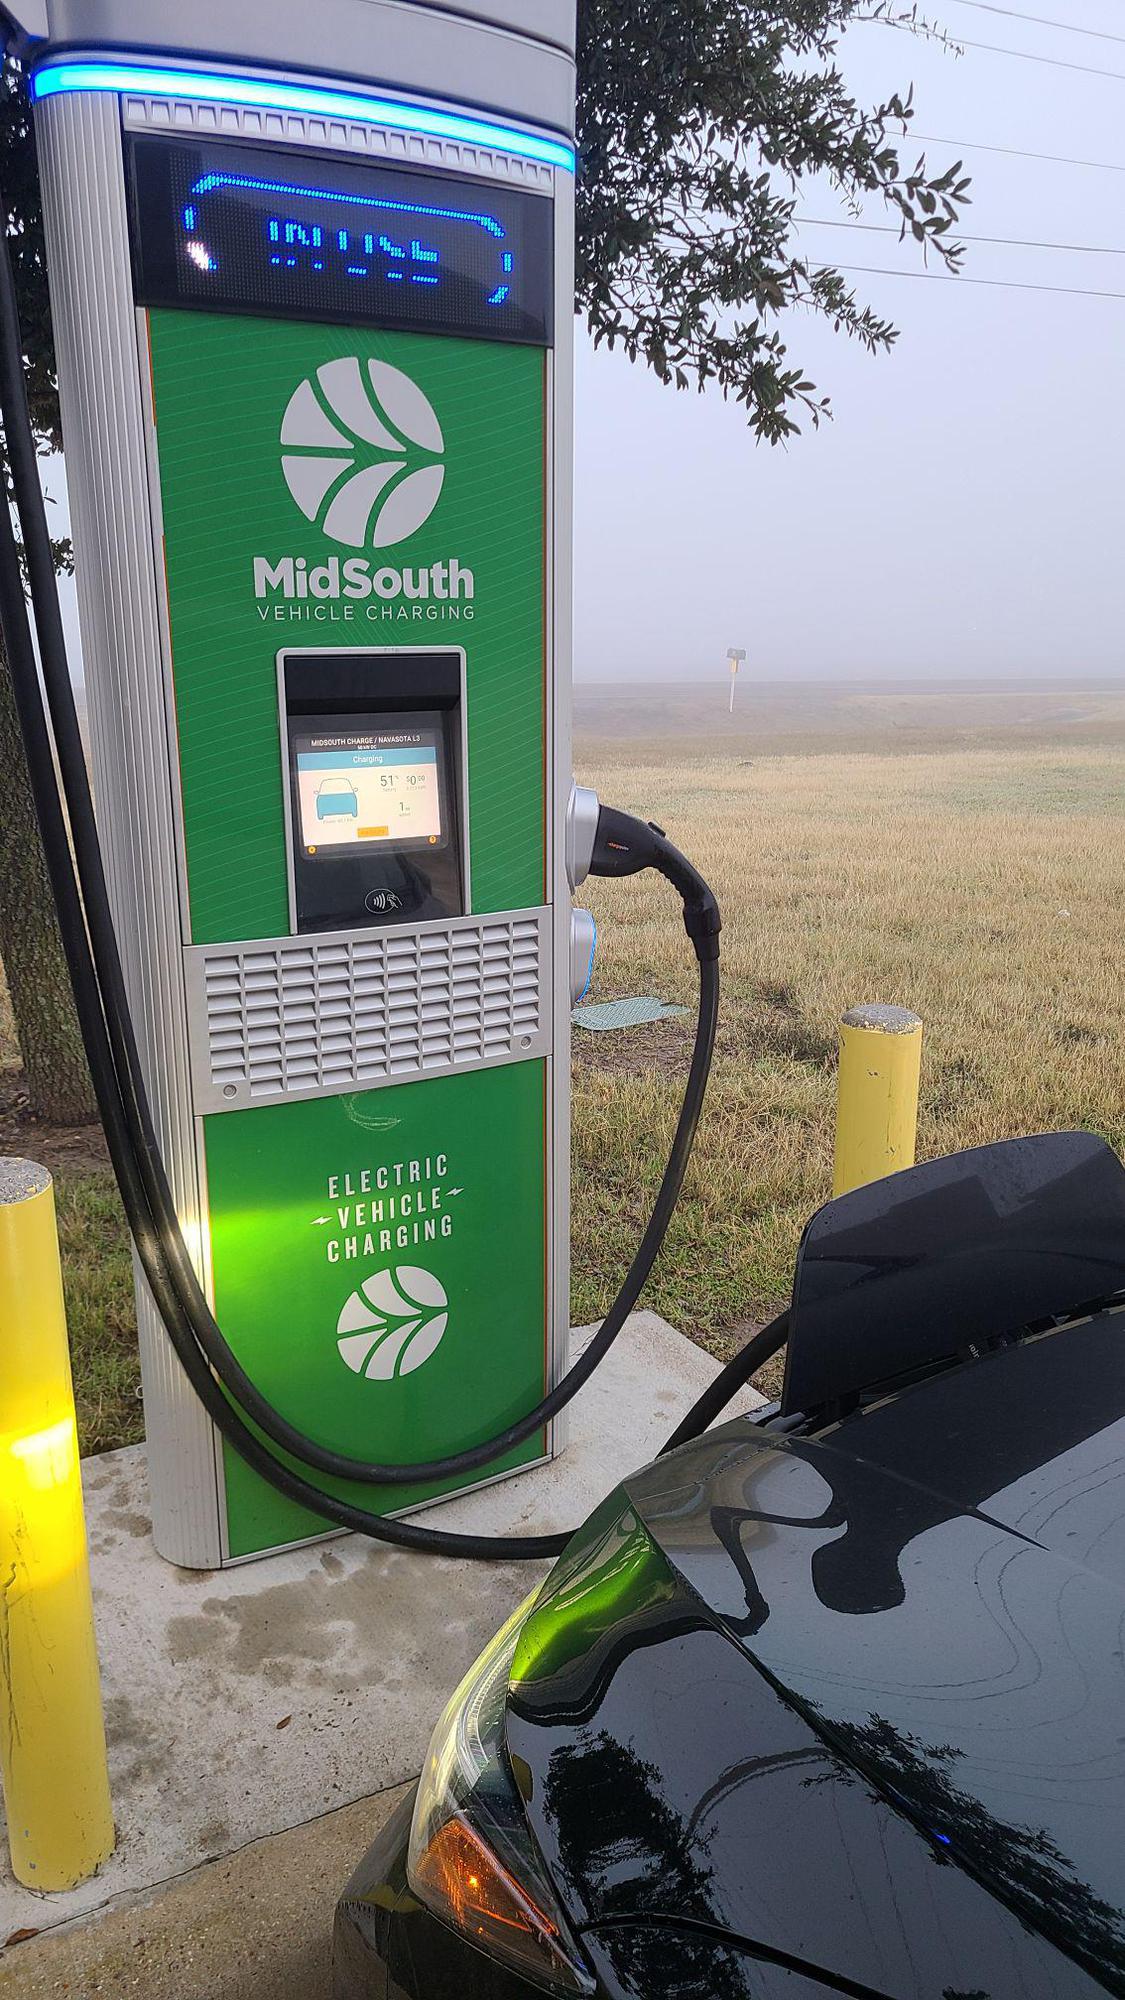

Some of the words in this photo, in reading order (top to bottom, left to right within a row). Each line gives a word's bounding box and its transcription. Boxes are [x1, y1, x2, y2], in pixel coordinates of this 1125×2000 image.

[253, 556, 475, 599] MidSouth
[257, 605, 354, 621] VEHICLE
[366, 605, 475, 620] CHARGING
[311, 738, 346, 747] MIDSOUTH
[347, 736, 373, 745] CHARGE
[352, 755, 384, 764] Charging
[328, 1154, 448, 1199] ELECTRIC
[338, 1187, 441, 1229] VEHICLE
[327, 1215, 453, 1263] CHARGING
